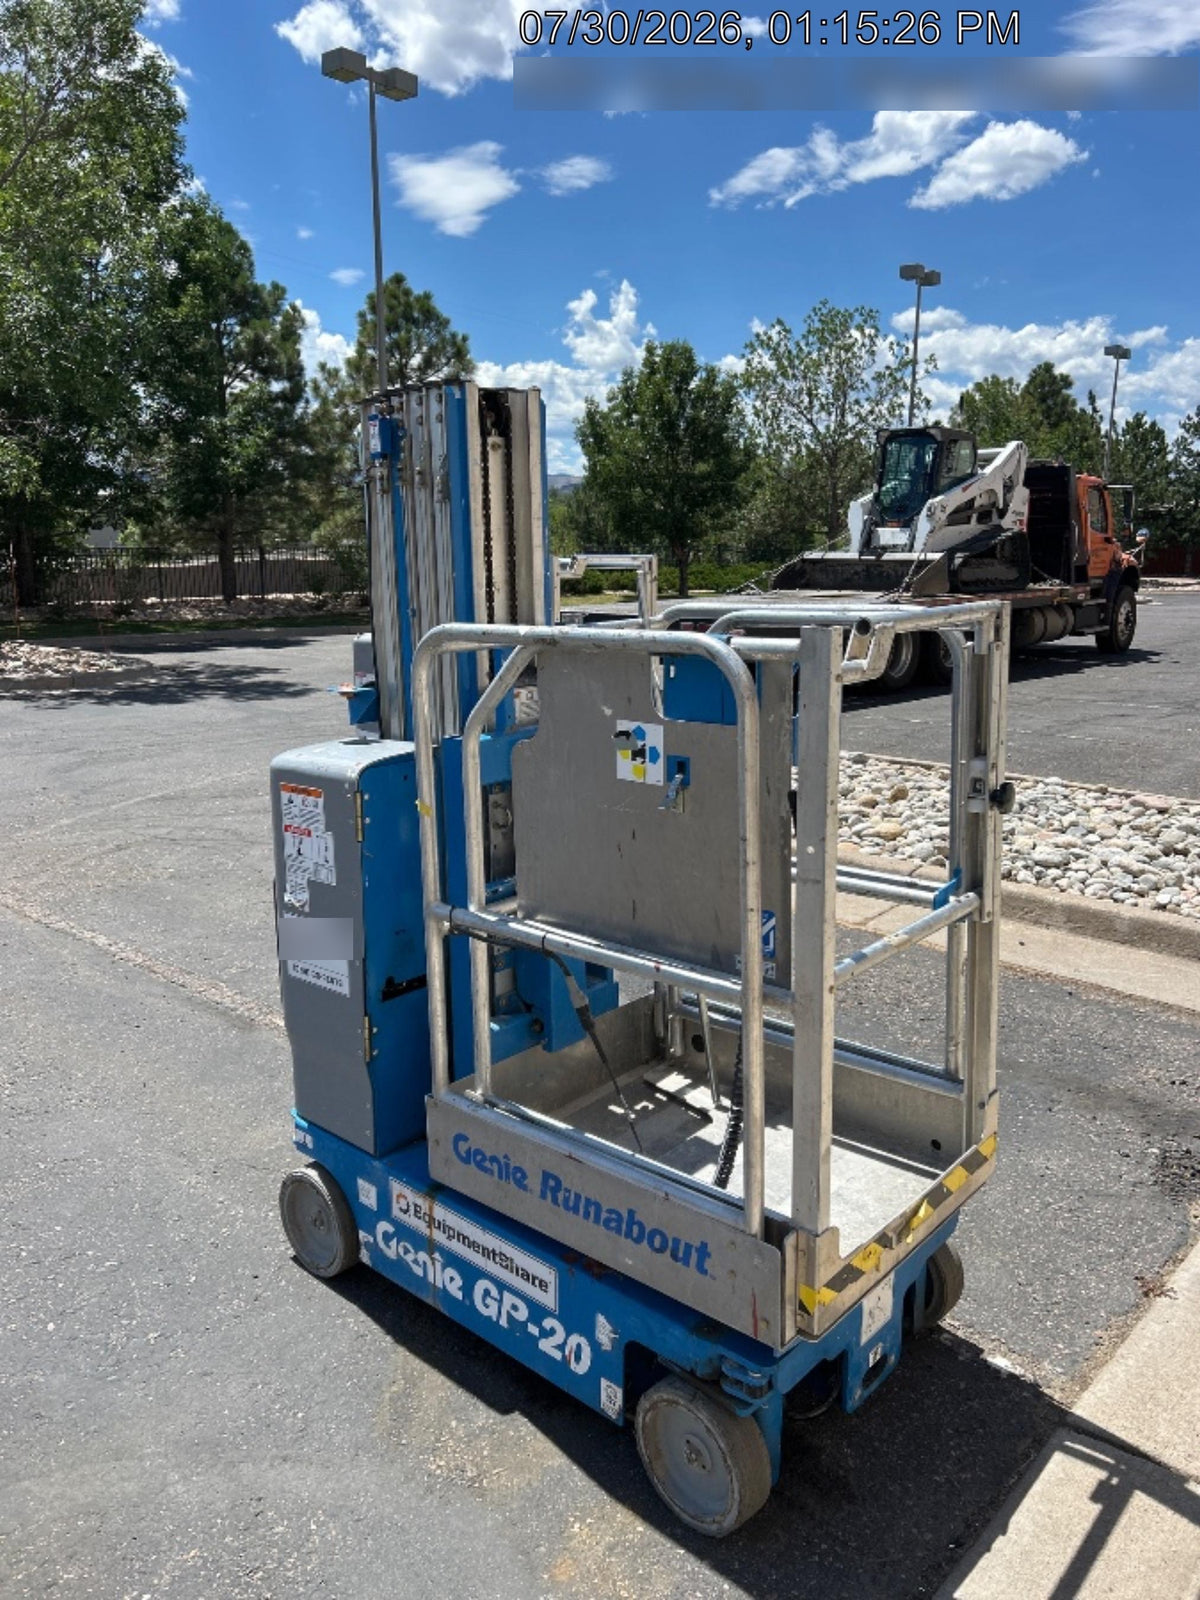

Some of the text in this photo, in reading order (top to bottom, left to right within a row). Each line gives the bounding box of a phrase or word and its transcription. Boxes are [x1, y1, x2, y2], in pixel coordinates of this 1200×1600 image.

[412, 1201, 549, 1295] EquipmentShare
[452, 1132, 713, 1276] Genie Runabout
[375, 1220, 463, 1301] Genie
[473, 1278, 592, 1375] GP-20
